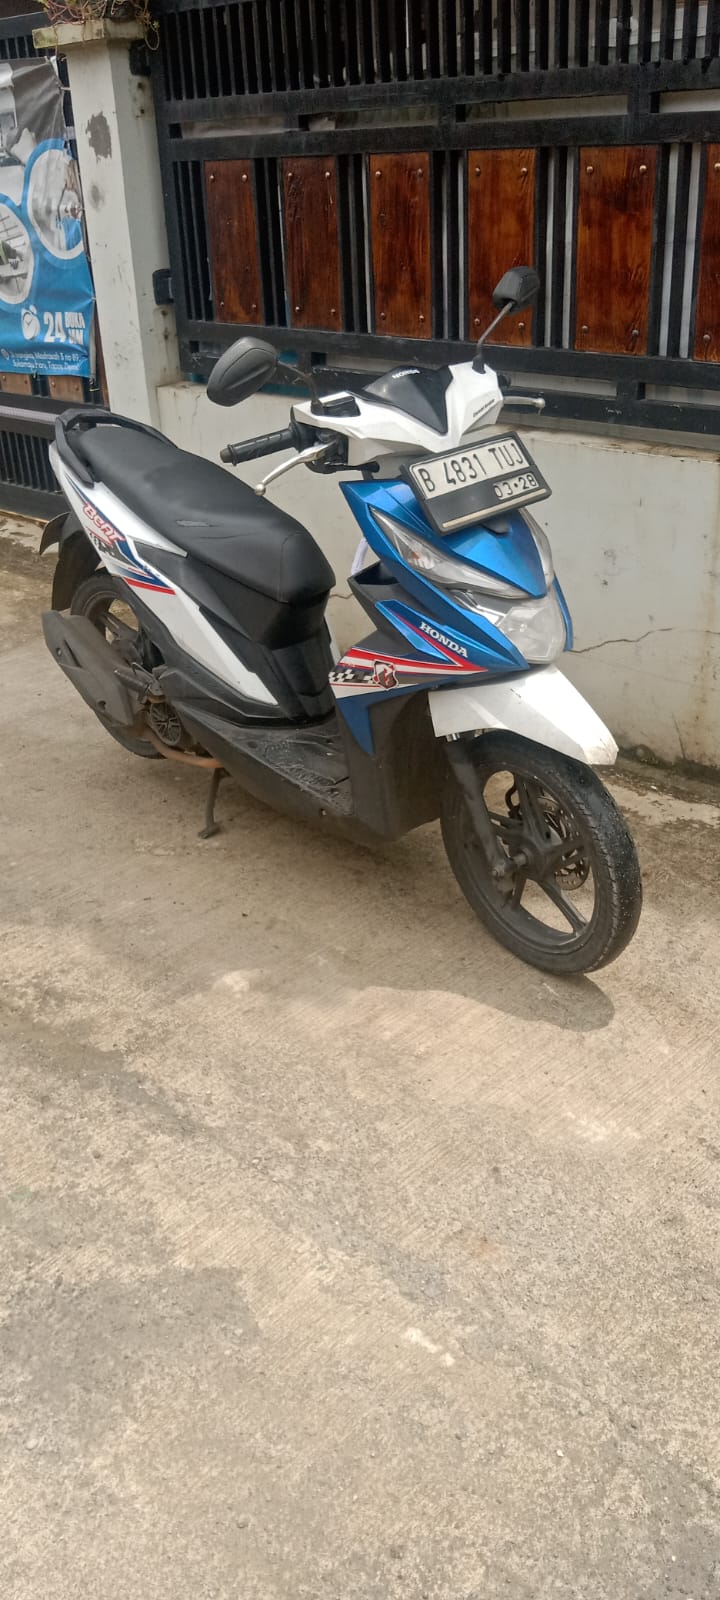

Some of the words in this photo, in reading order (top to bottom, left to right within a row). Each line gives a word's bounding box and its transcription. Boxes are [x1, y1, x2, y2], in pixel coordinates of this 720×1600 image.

[43, 311, 66, 343] 24
[391, 369, 420, 379] HONDA
[417, 467, 436, 493] B
[443, 453, 488, 485] 4831
[488, 442, 524, 470] TUJ
[419, 621, 469, 659] HONDA
